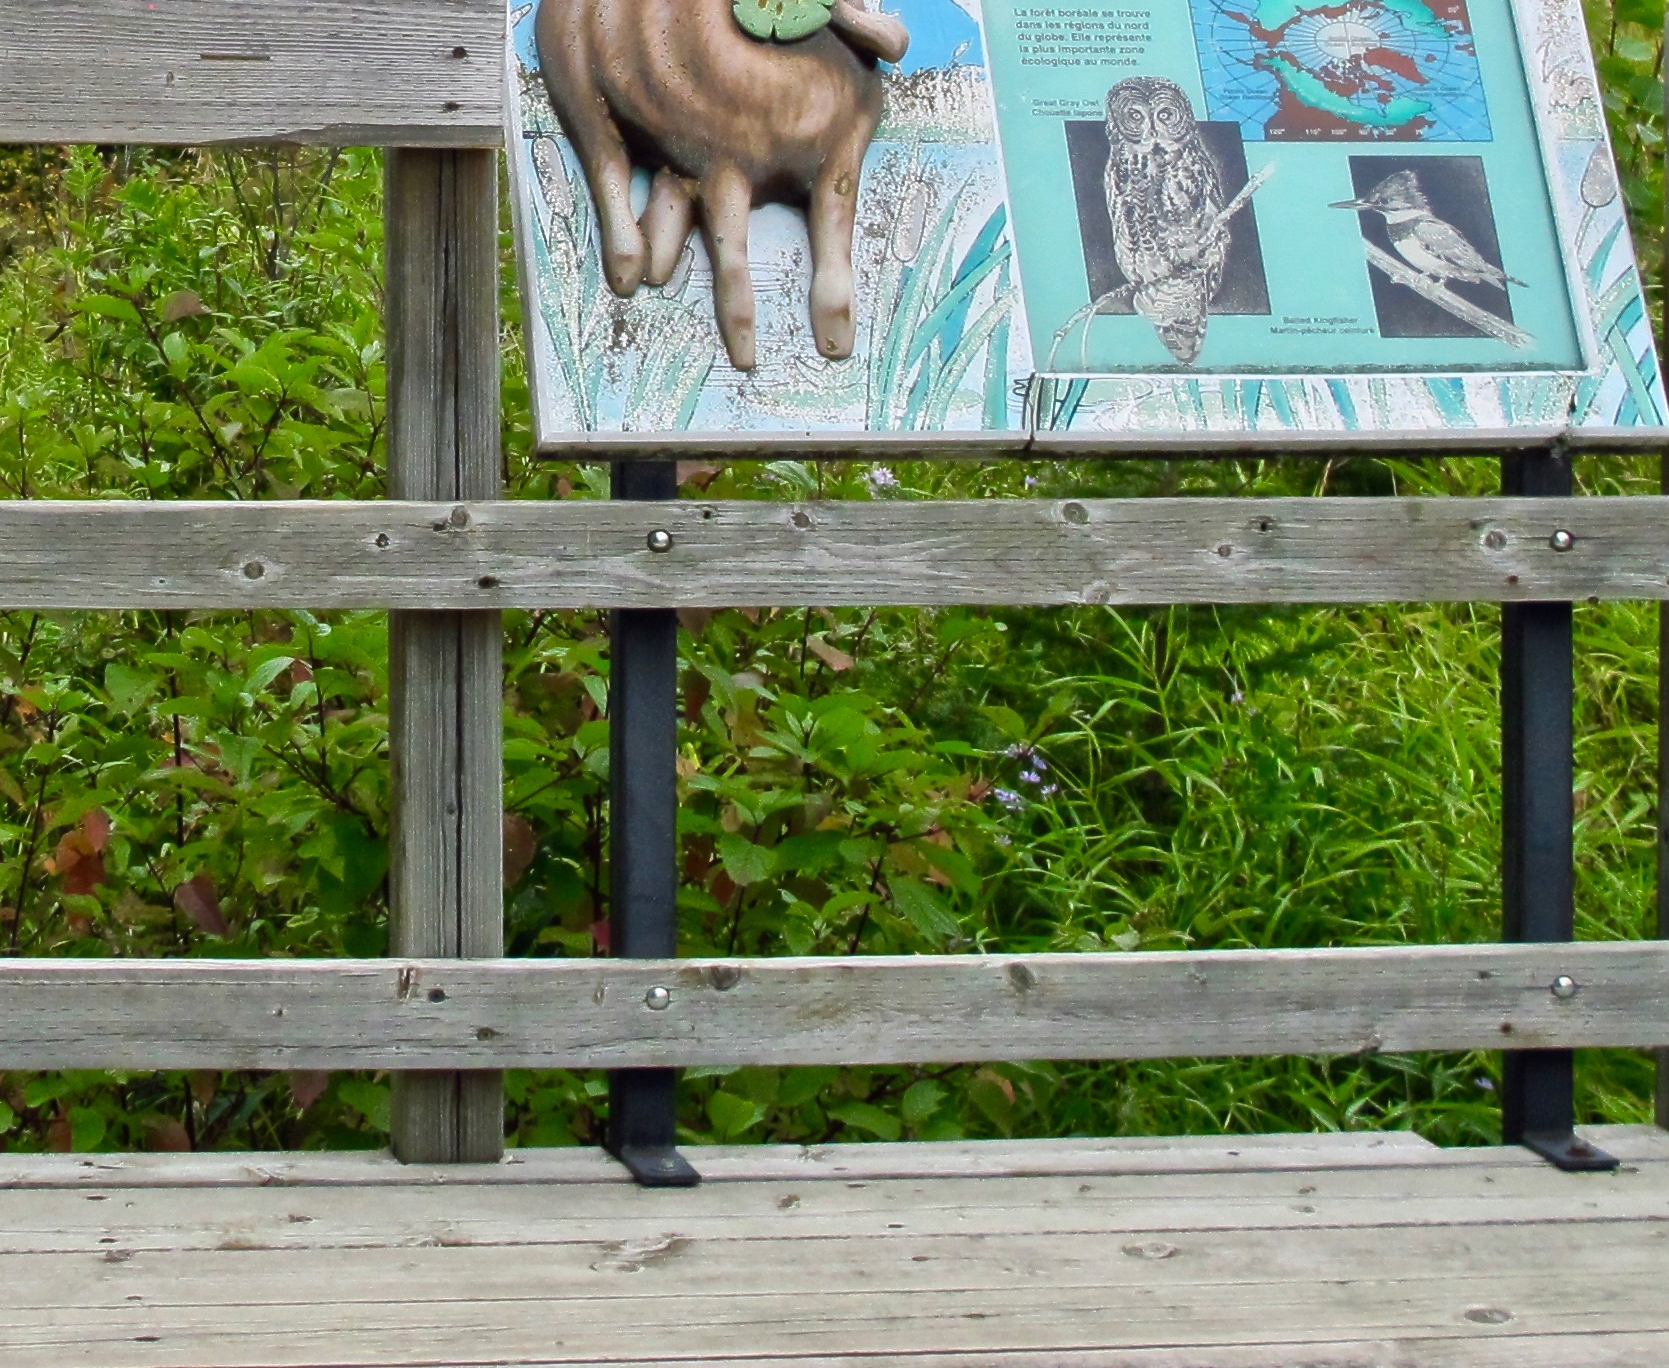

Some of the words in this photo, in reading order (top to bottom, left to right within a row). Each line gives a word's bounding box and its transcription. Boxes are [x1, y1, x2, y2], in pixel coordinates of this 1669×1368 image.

[1013, 8, 1028, 17] La
[1030, 8, 1055, 17] forêt
[1058, 8, 1099, 17] boréale
[1116, 9, 1151, 18] trouve
[1015, 20, 1043, 29] dans
[1045, 20, 1061, 29] les
[1063, 20, 1105, 31] régions
[1107, 21, 1122, 30] du
[1124, 21, 1150, 30] nord
[1017, 32, 1032, 41] du
[1071, 32, 1091, 41] Elle
[1094, 33, 1152, 44] représente
[1019, 44, 1029, 53] la
[1032, 45, 1056, 56] plus
[1058, 45, 1117, 56] importante
